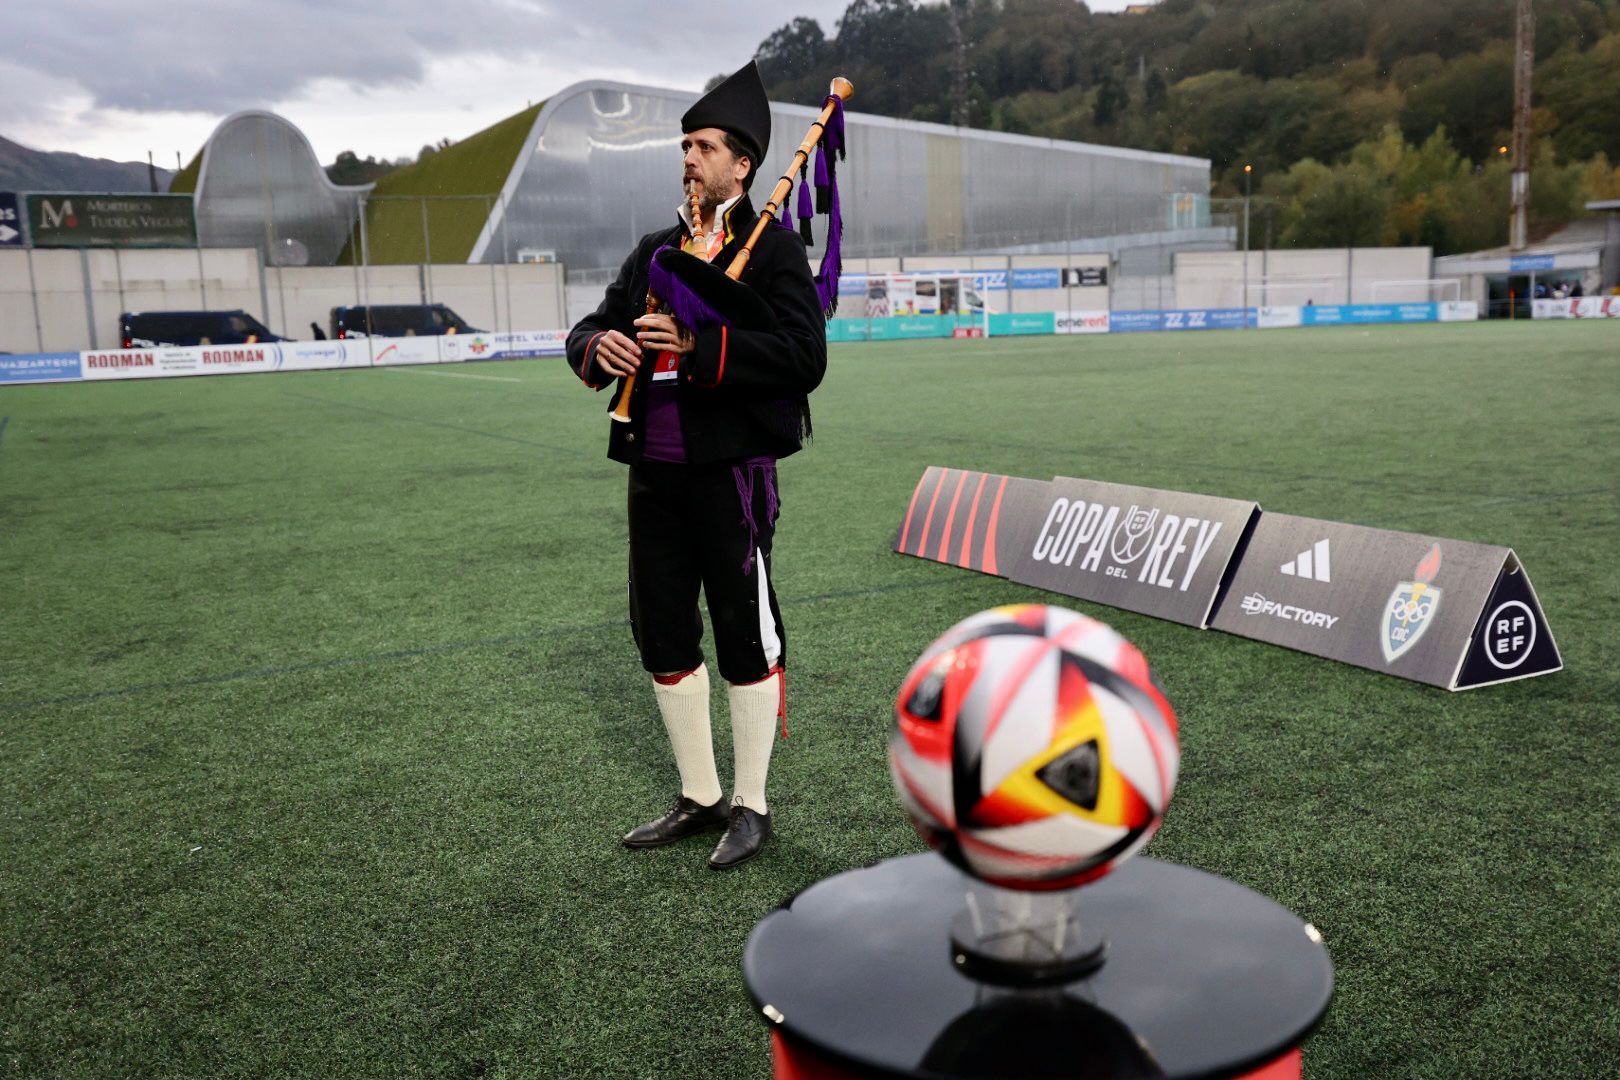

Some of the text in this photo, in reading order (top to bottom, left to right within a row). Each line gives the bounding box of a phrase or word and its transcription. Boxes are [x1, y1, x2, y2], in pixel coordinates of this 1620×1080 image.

[87, 353, 154, 369] RODMAN
[203, 349, 265, 364] RODMAN
[1032, 497, 1121, 573] COPA
[1138, 514, 1224, 592] REY
[1105, 565, 1129, 579] DEL
[1497, 616, 1525, 635] RF
[1496, 635, 1525, 654] EF
